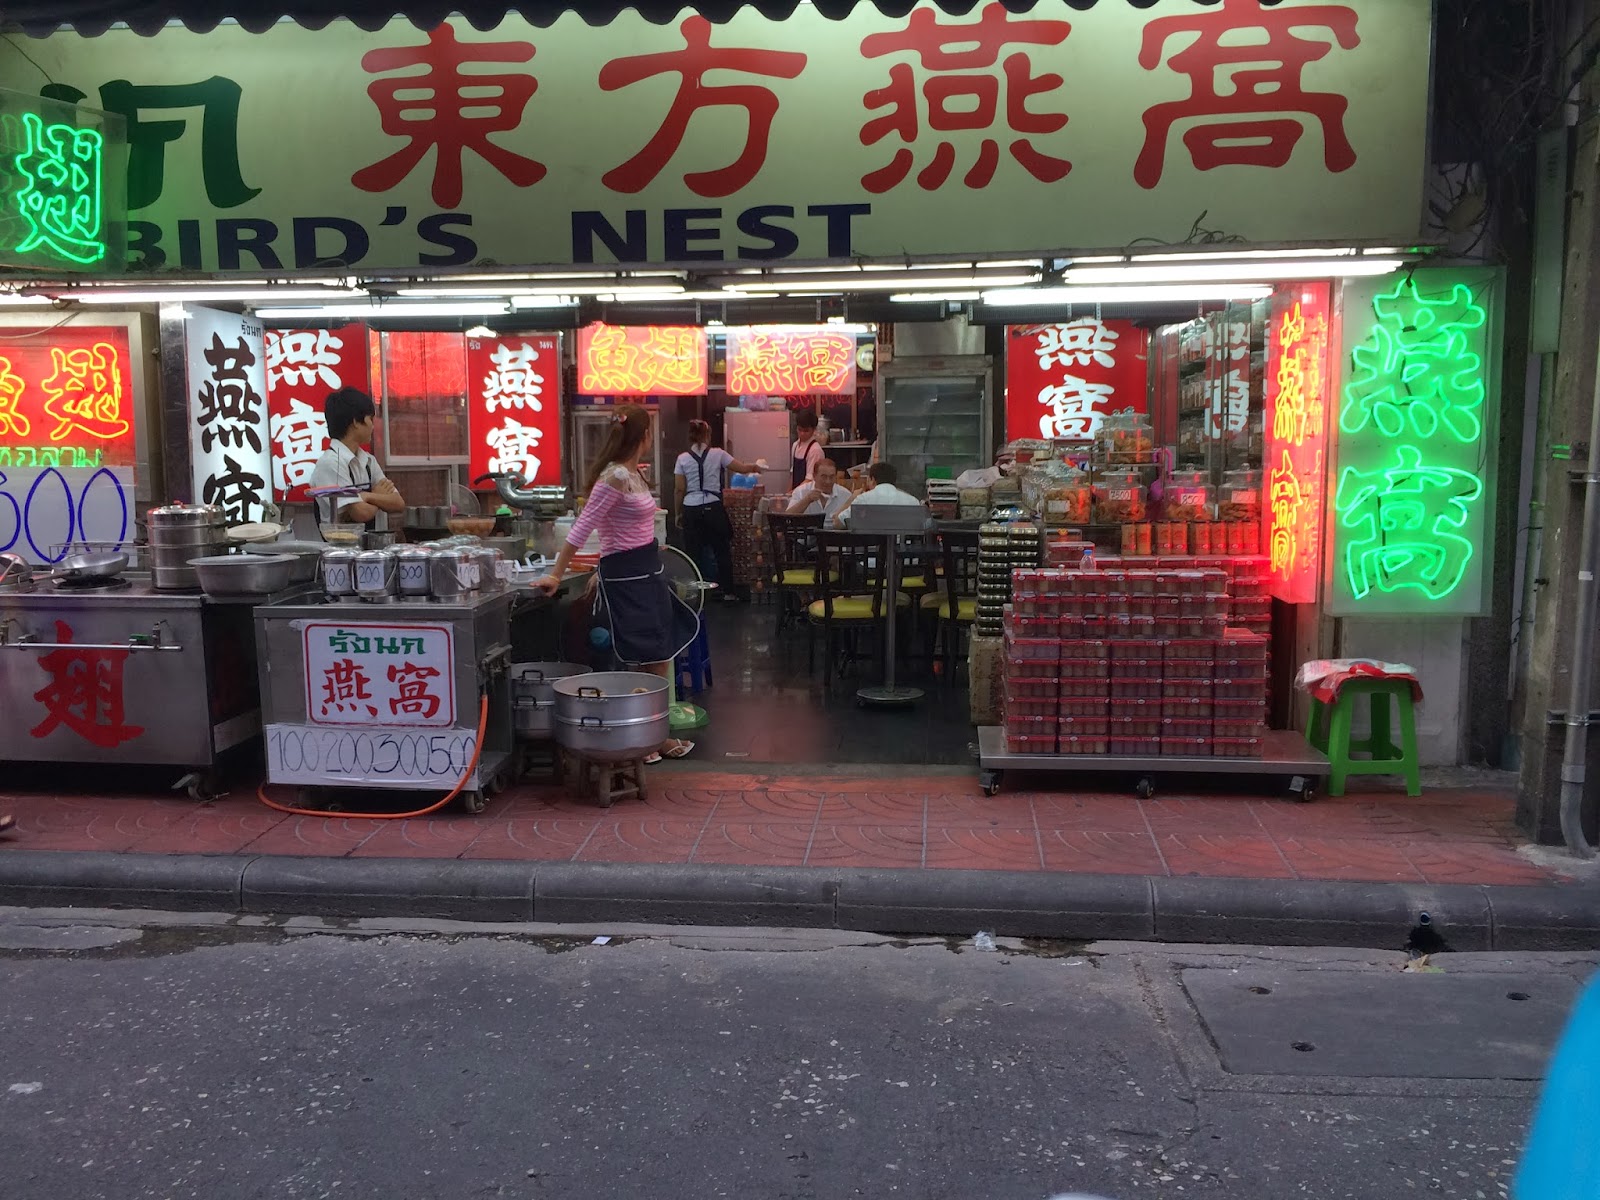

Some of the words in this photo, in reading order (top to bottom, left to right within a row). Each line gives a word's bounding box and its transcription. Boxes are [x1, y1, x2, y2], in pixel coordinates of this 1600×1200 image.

[351, 1, 1362, 209] 東方燕窩
[127, 206, 475, 269] BIRD'S
[572, 204, 870, 263] NEST
[482, 342, 545, 485] 燕窩
[1336, 280, 1486, 600] 燕窩
[358, 566, 380, 584] 200
[400, 565, 423, 580] 300
[329, 630, 426, 655] รังนก
[30, 620, 145, 748] 翅
[321, 658, 441, 719] 燕窩
